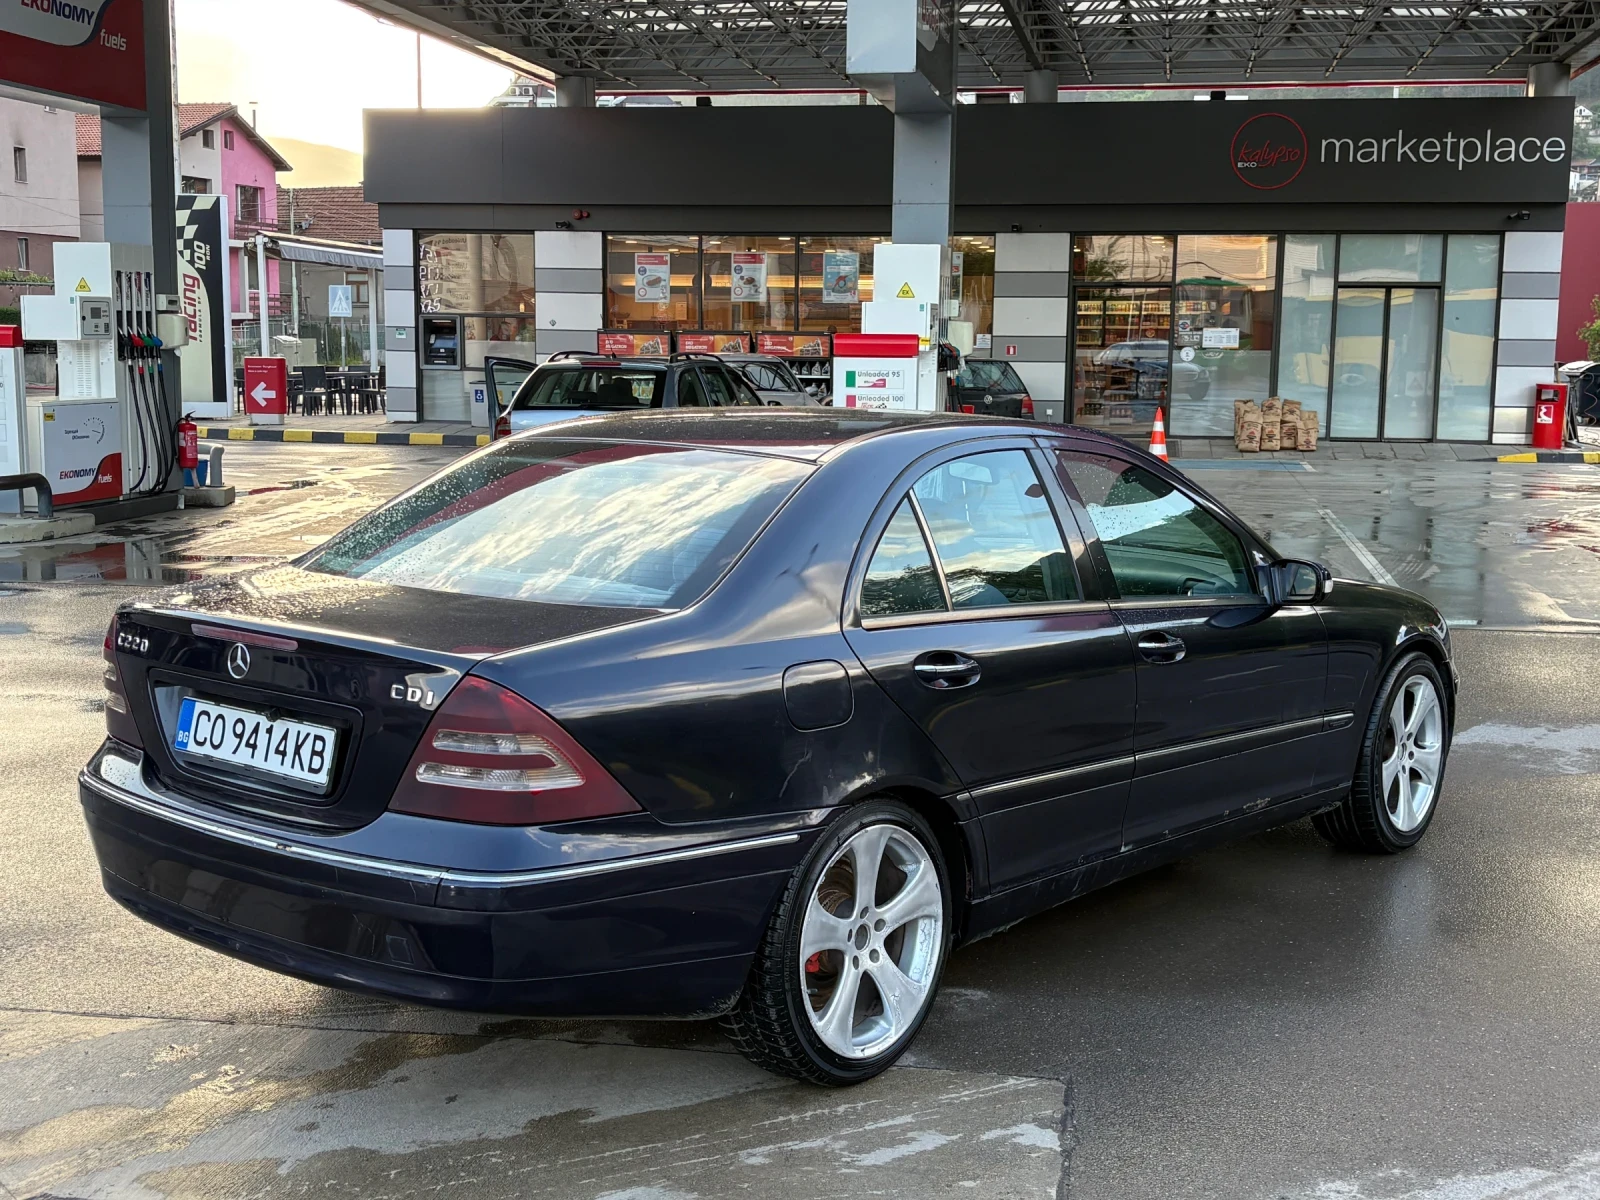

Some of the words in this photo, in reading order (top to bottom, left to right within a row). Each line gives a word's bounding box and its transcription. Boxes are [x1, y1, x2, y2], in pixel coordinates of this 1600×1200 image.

[100, 29, 127, 51] fuels
[1321, 129, 1565, 170] marketplace
[193, 240, 206, 270] 100
[59, 468, 96, 480] EKONOMY
[98, 473, 113, 483] fuels
[117, 632, 149, 652] C220
[390, 684, 435, 706] CDI
[178, 730, 189, 744] BG
